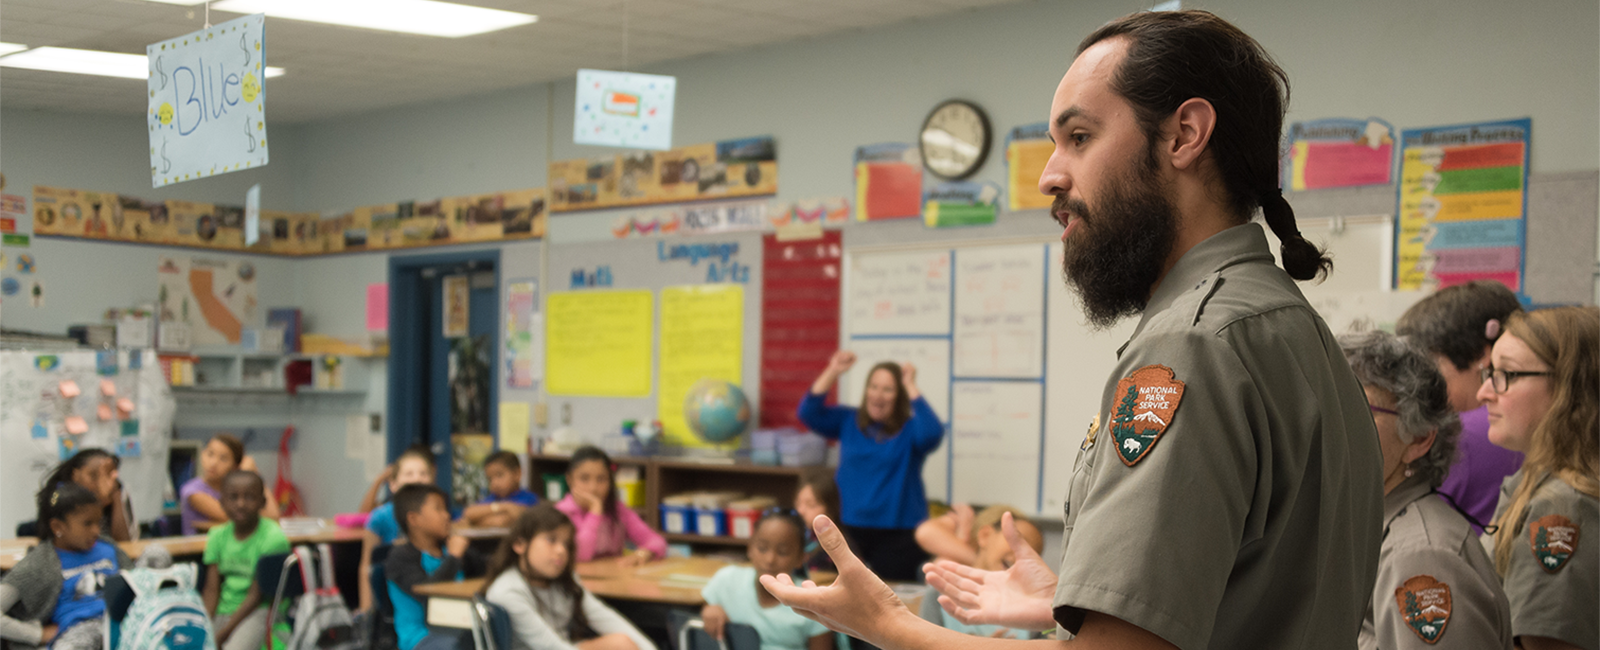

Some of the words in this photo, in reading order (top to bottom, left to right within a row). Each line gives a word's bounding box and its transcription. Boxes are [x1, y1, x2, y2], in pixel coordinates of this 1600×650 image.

[173, 57, 239, 136] Blue
[657, 240, 739, 266] Language
[570, 264, 613, 290] Math
[706, 261, 750, 285] Arts
[1139, 386, 1178, 394] NATIONAL
[1138, 401, 1170, 409] SERVICE
